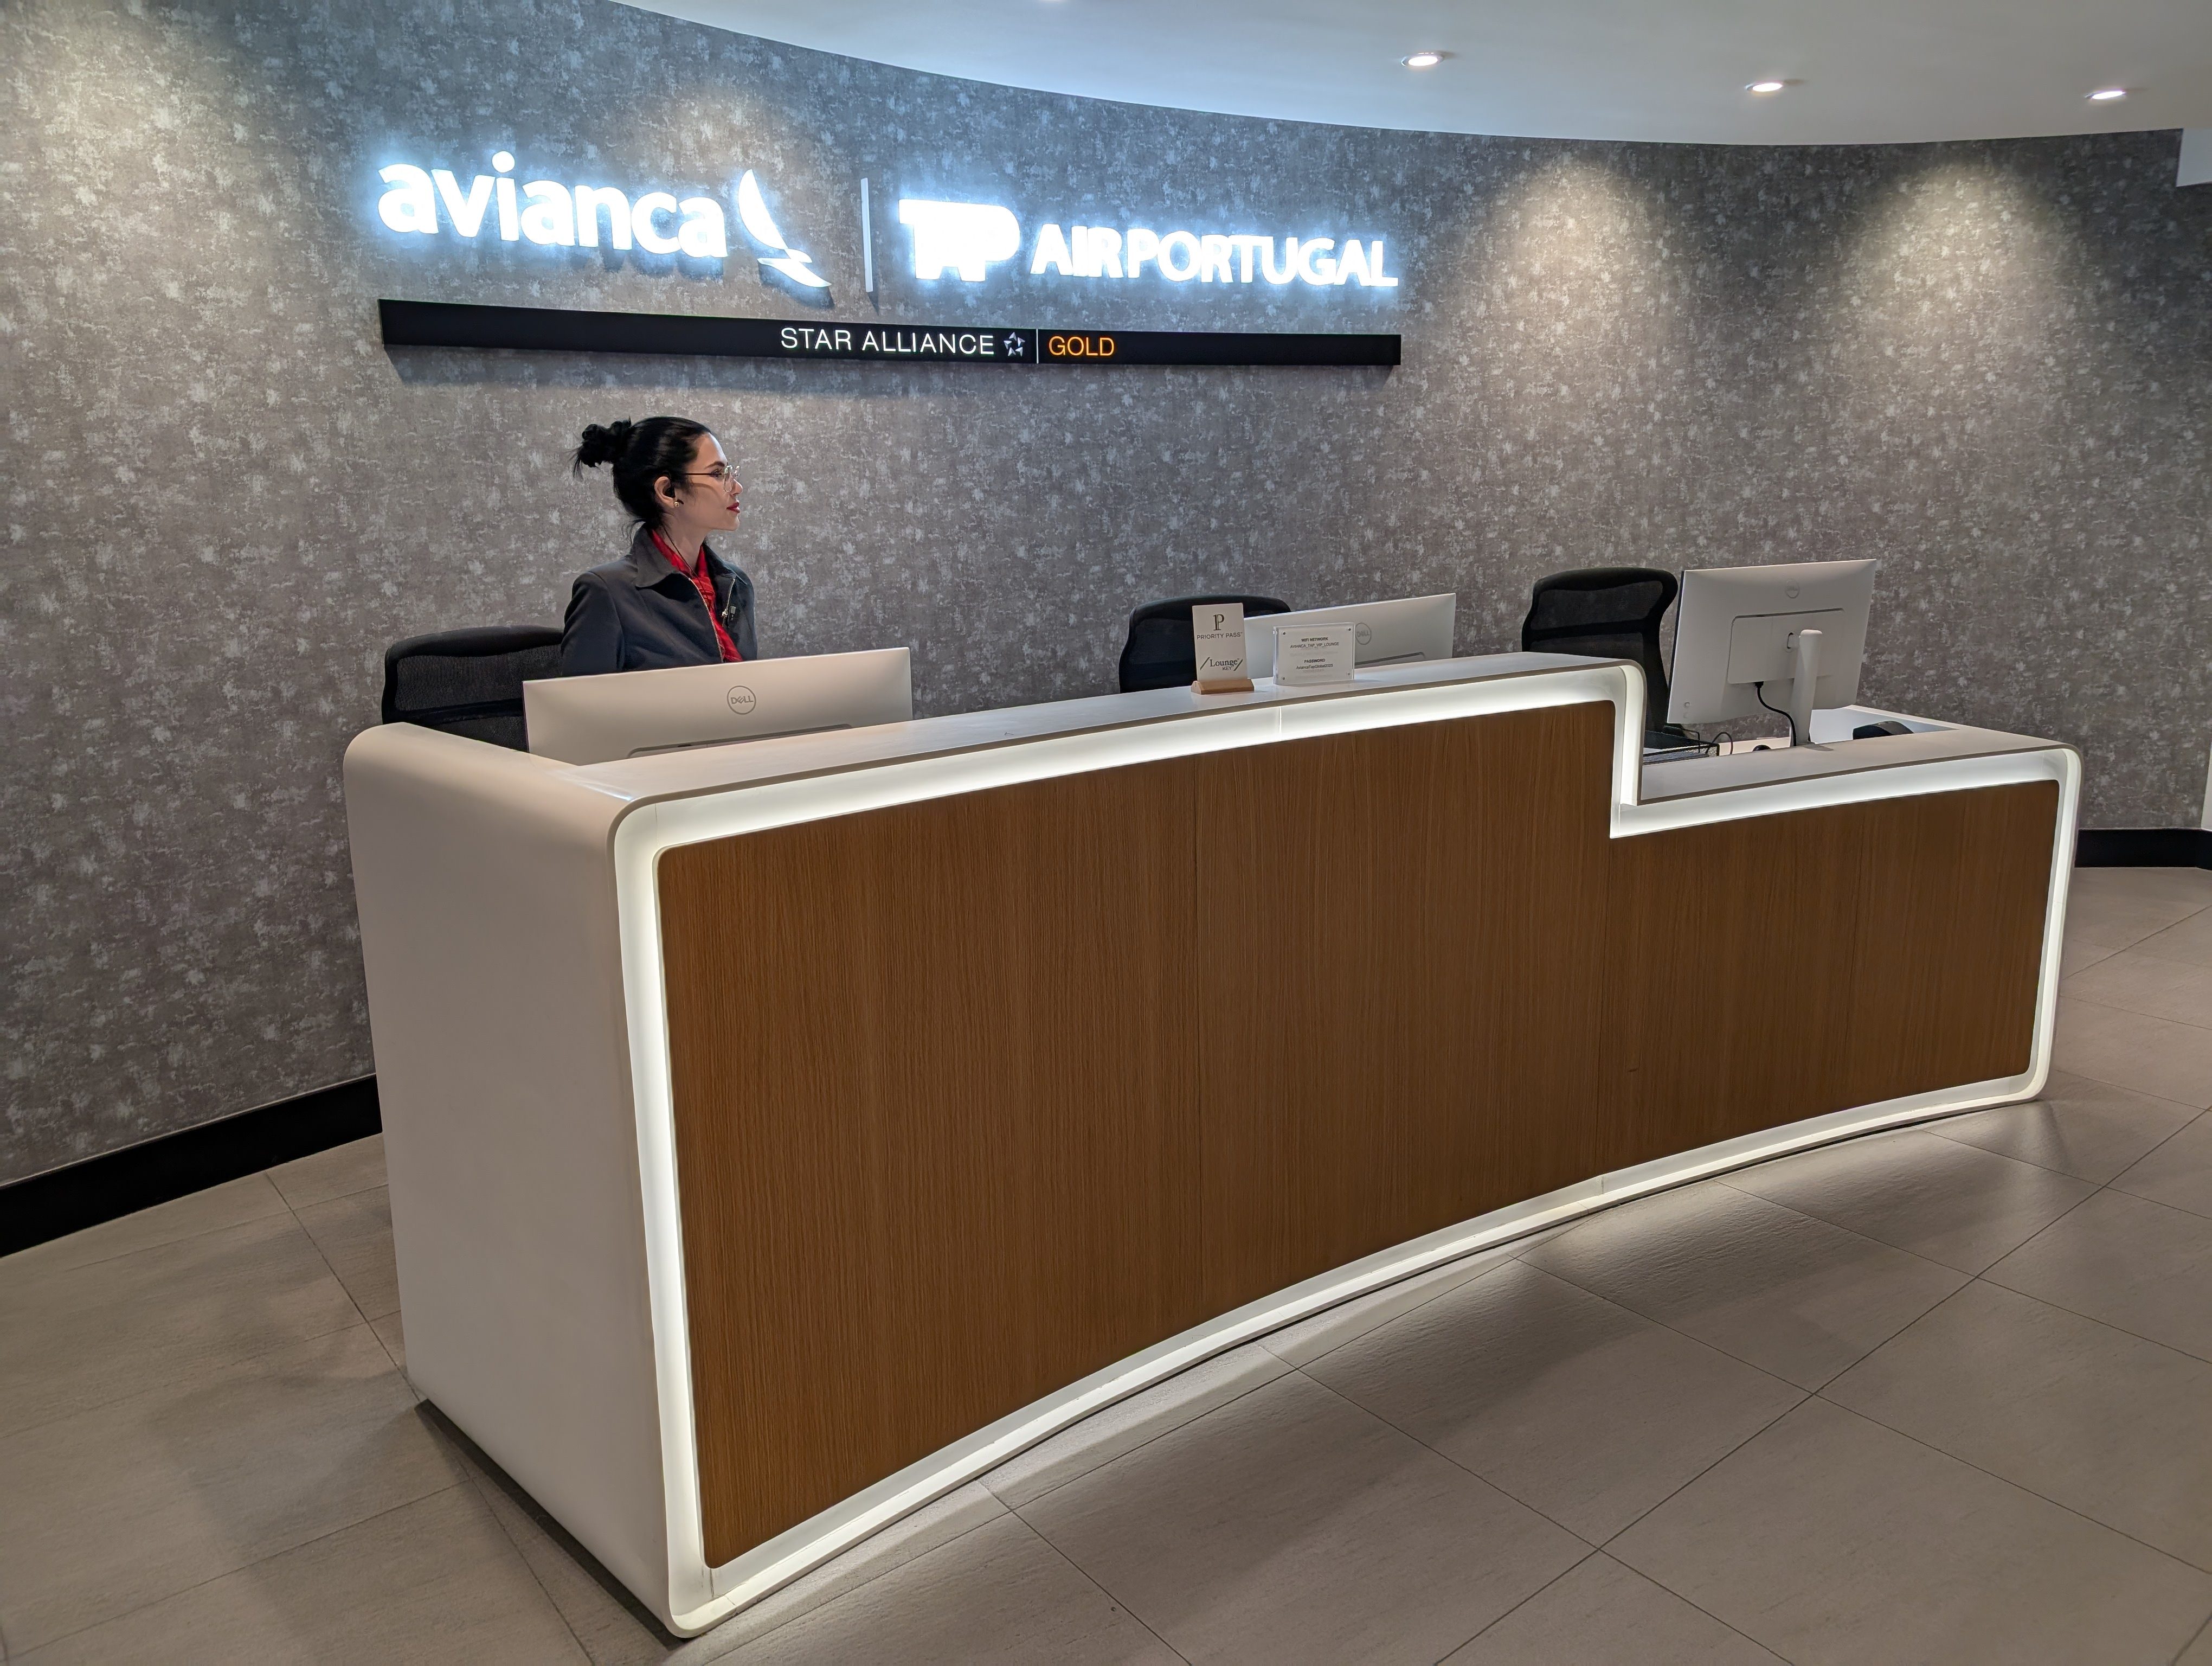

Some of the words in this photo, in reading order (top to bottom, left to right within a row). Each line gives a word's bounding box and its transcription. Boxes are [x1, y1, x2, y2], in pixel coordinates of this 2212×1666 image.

[377, 150, 728, 258] avianca
[781, 328, 852, 351] STAR
[862, 330, 995, 355] ALLIANCE
[1048, 336, 1115, 356] GOLD
[730, 695, 754, 704] DELL
